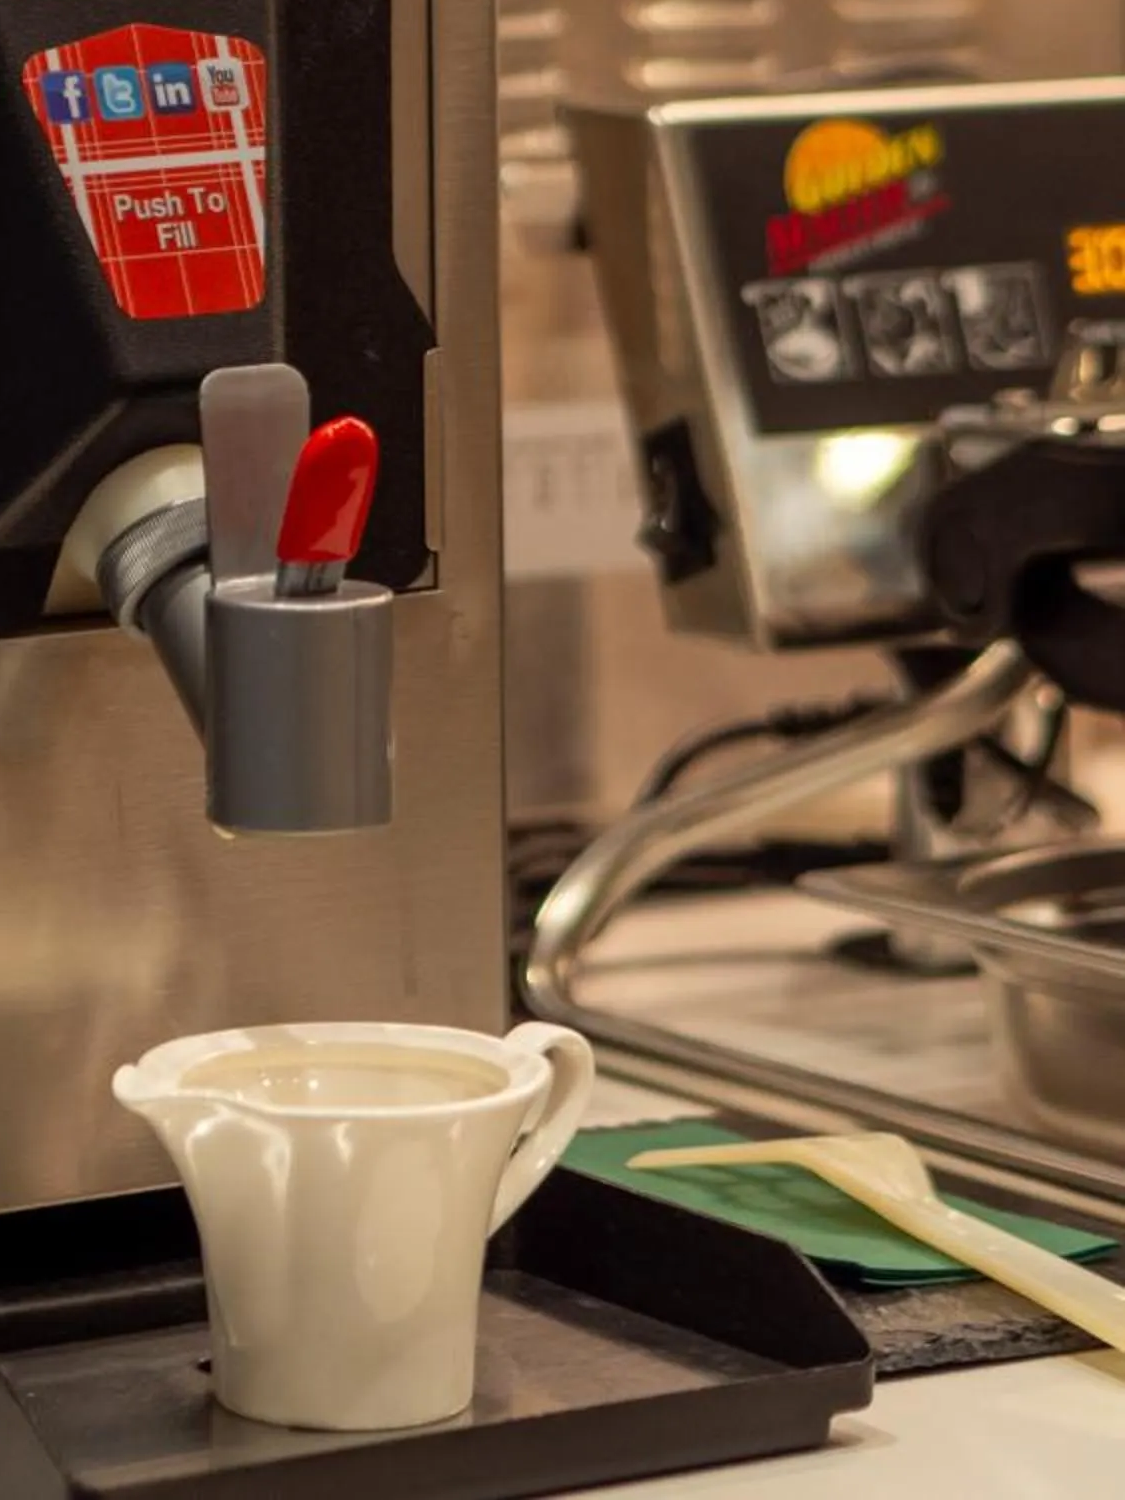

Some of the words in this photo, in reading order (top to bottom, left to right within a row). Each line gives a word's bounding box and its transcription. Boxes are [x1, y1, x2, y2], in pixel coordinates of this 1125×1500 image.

[151, 72, 192, 108] in
[207, 64, 235, 85] You
[62, 74, 83, 119] f
[113, 190, 185, 222] Push
[187, 186, 226, 214] To
[156, 219, 197, 251] Fill
